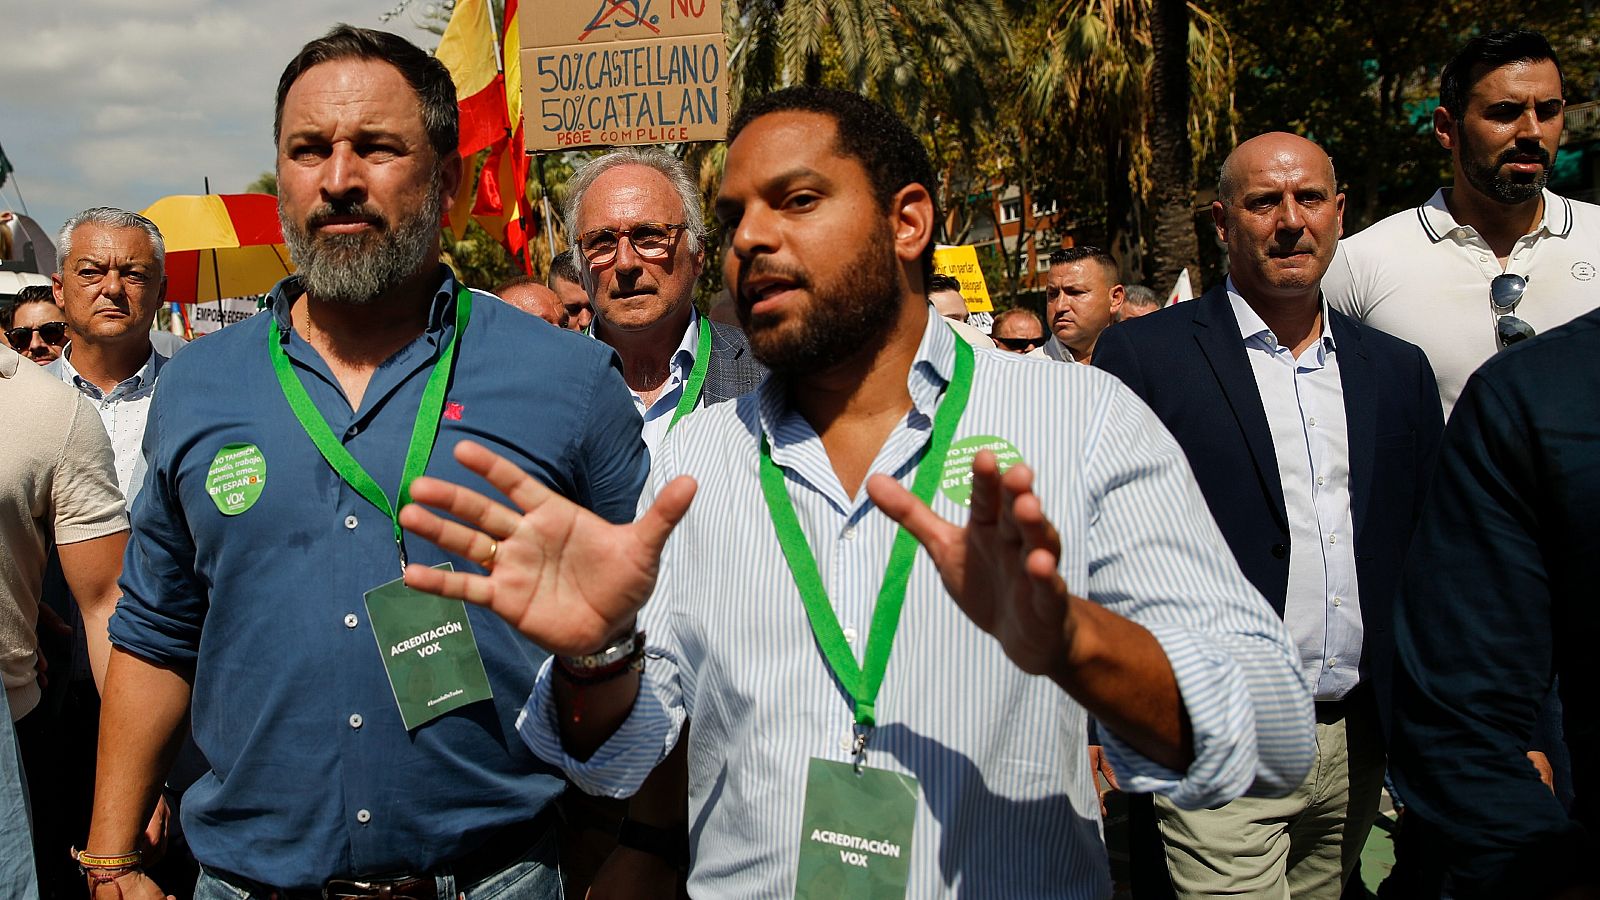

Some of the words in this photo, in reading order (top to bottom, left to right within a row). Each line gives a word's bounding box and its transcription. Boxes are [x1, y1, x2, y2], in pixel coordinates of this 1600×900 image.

[557, 130, 592, 145] PSOE
[215, 457, 224, 465] YO
[225, 447, 255, 462] TAMBIÉN
[209, 485, 221, 496] EN
[223, 475, 263, 492] ESPAÑOL
[942, 477, 960, 489] EN
[226, 491, 245, 505] VOX
[391, 621, 463, 657] ACREDITACIÓN
[417, 642, 443, 658] VOX
[810, 829, 901, 858] ACREDITACIÓN
[840, 850, 868, 868] VOX
